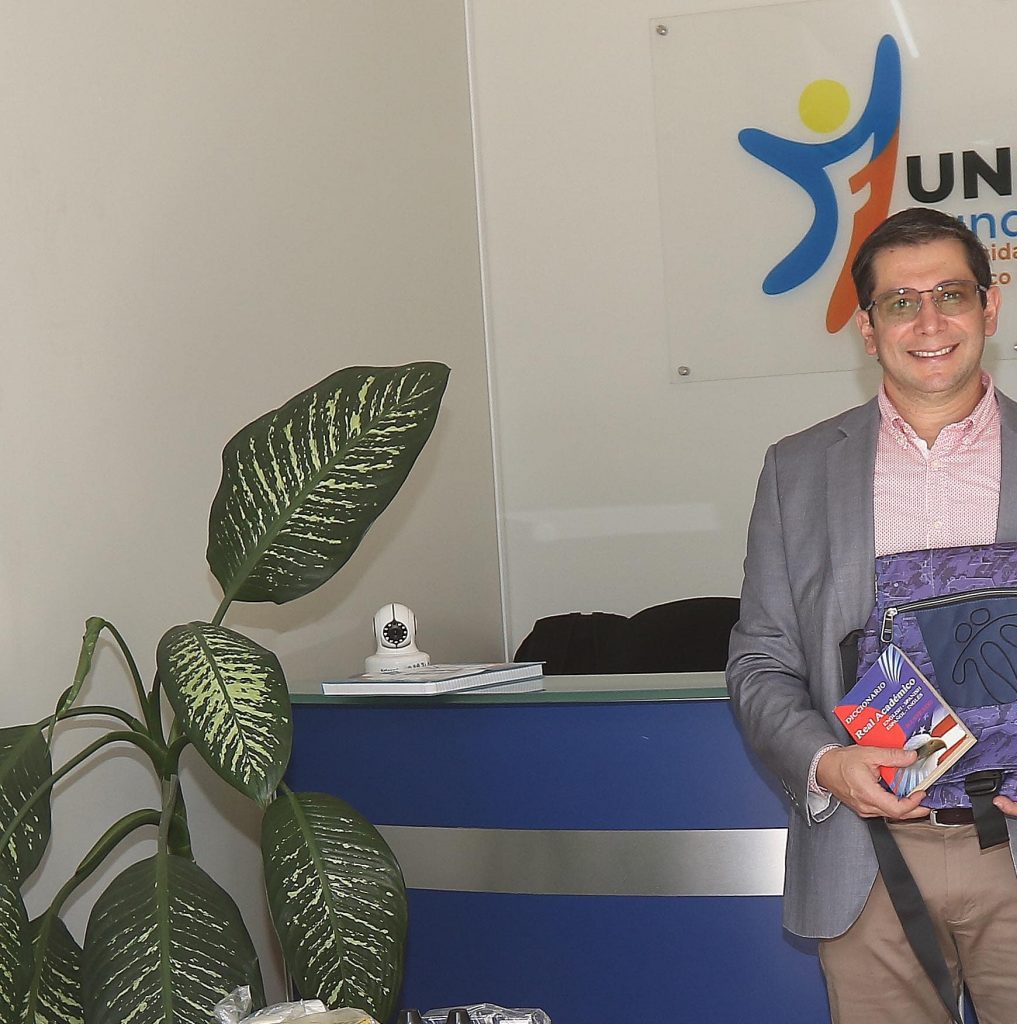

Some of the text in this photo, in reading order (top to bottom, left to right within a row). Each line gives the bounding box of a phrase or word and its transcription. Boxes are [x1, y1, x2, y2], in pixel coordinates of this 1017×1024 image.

[844, 680, 887, 725] DICCIONARIO
[855, 677, 917, 740] Real Académico
